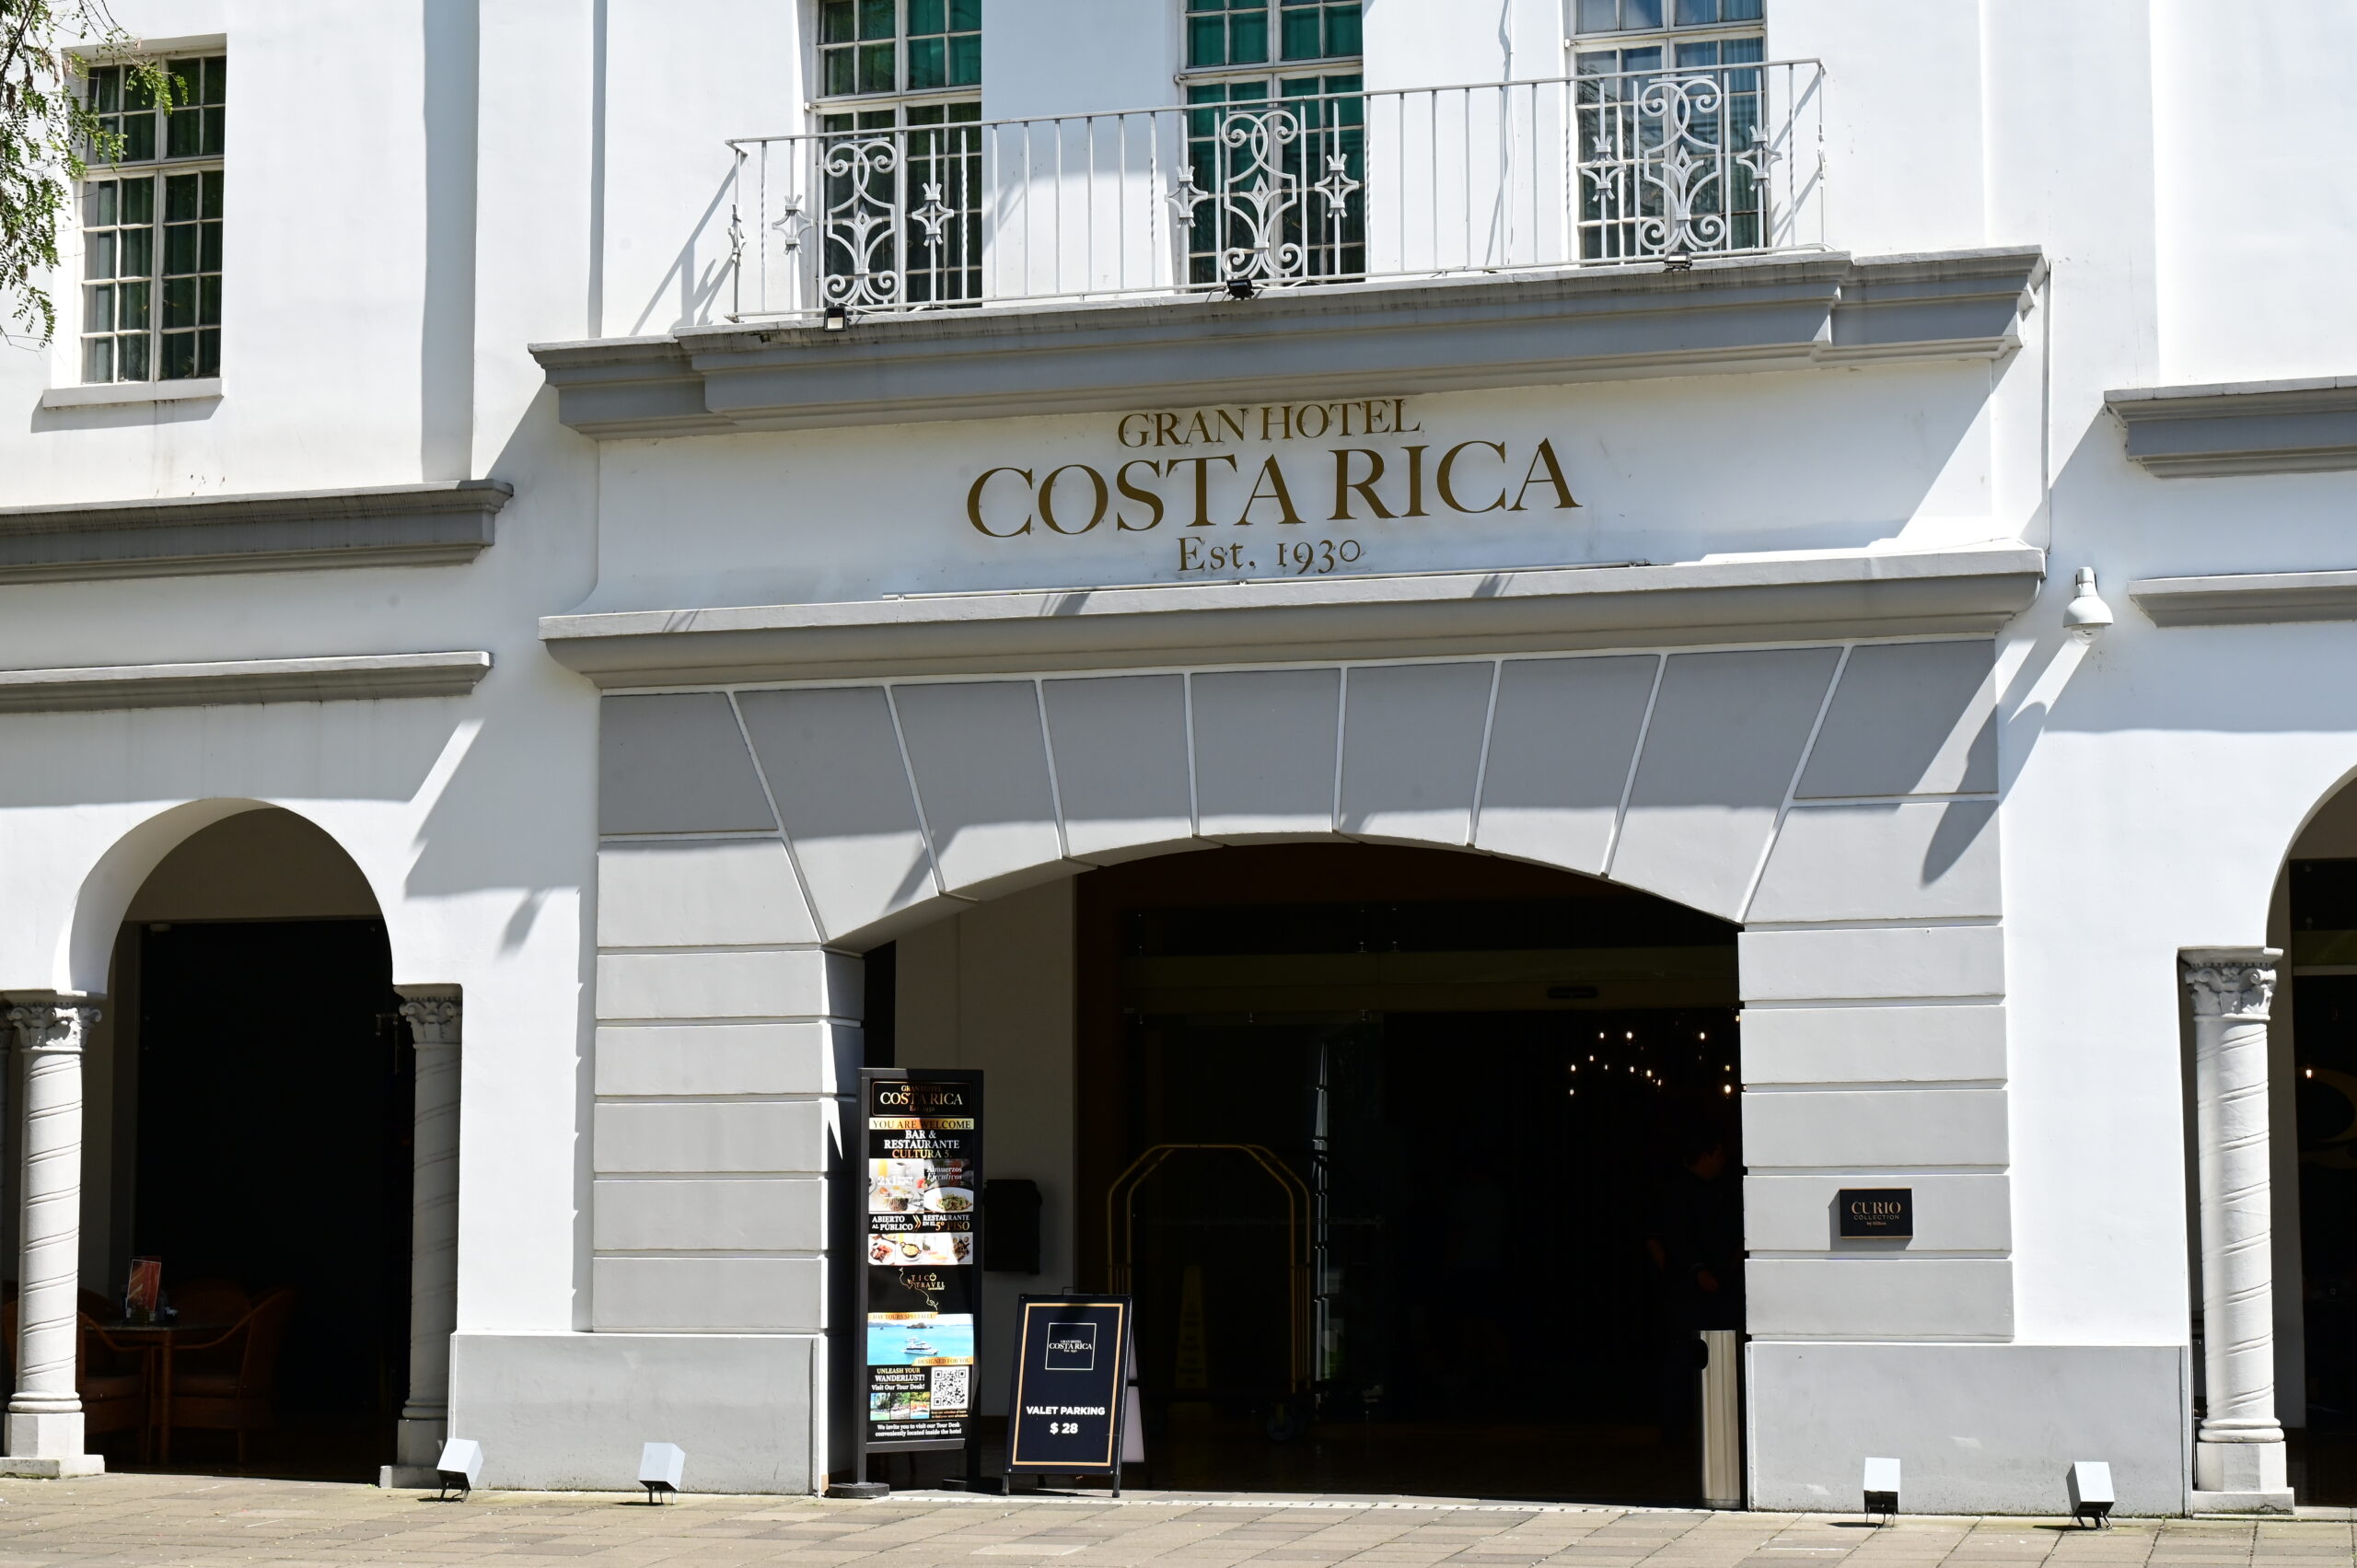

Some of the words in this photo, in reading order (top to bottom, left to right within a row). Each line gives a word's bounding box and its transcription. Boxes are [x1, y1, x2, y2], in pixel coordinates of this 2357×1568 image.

[1118, 408, 1247, 447] GRAN
[1260, 399, 1422, 441] HOTEL
[966, 454, 1306, 538] COSTA
[1326, 436, 1584, 521] RICA
[1176, 536, 1256, 573] Est.
[1276, 539, 1361, 575] 1930
[879, 1092, 927, 1105] COSTA
[930, 1093, 963, 1105] RICA
[873, 1120, 895, 1129] YOU
[897, 1120, 917, 1129] ARE
[921, 1120, 971, 1129] WELCOME
[905, 1130, 926, 1140] BAR
[928, 1130, 936, 1139] &
[884, 1139, 960, 1149] RESTAURANTE
[891, 1149, 942, 1158] CULTURA
[926, 1165, 962, 1173] Almuerzos
[926, 1172, 962, 1182] Ejecutivos
[1851, 1201, 1901, 1214] CURIO
[879, 1222, 913, 1231] PÚBLICO
[946, 1221, 970, 1231] PISO
[1026, 1406, 1059, 1414] VALET
[1060, 1406, 1106, 1416] PARKING
[1050, 1422, 1059, 1434] $
[1061, 1423, 1078, 1434] 28
